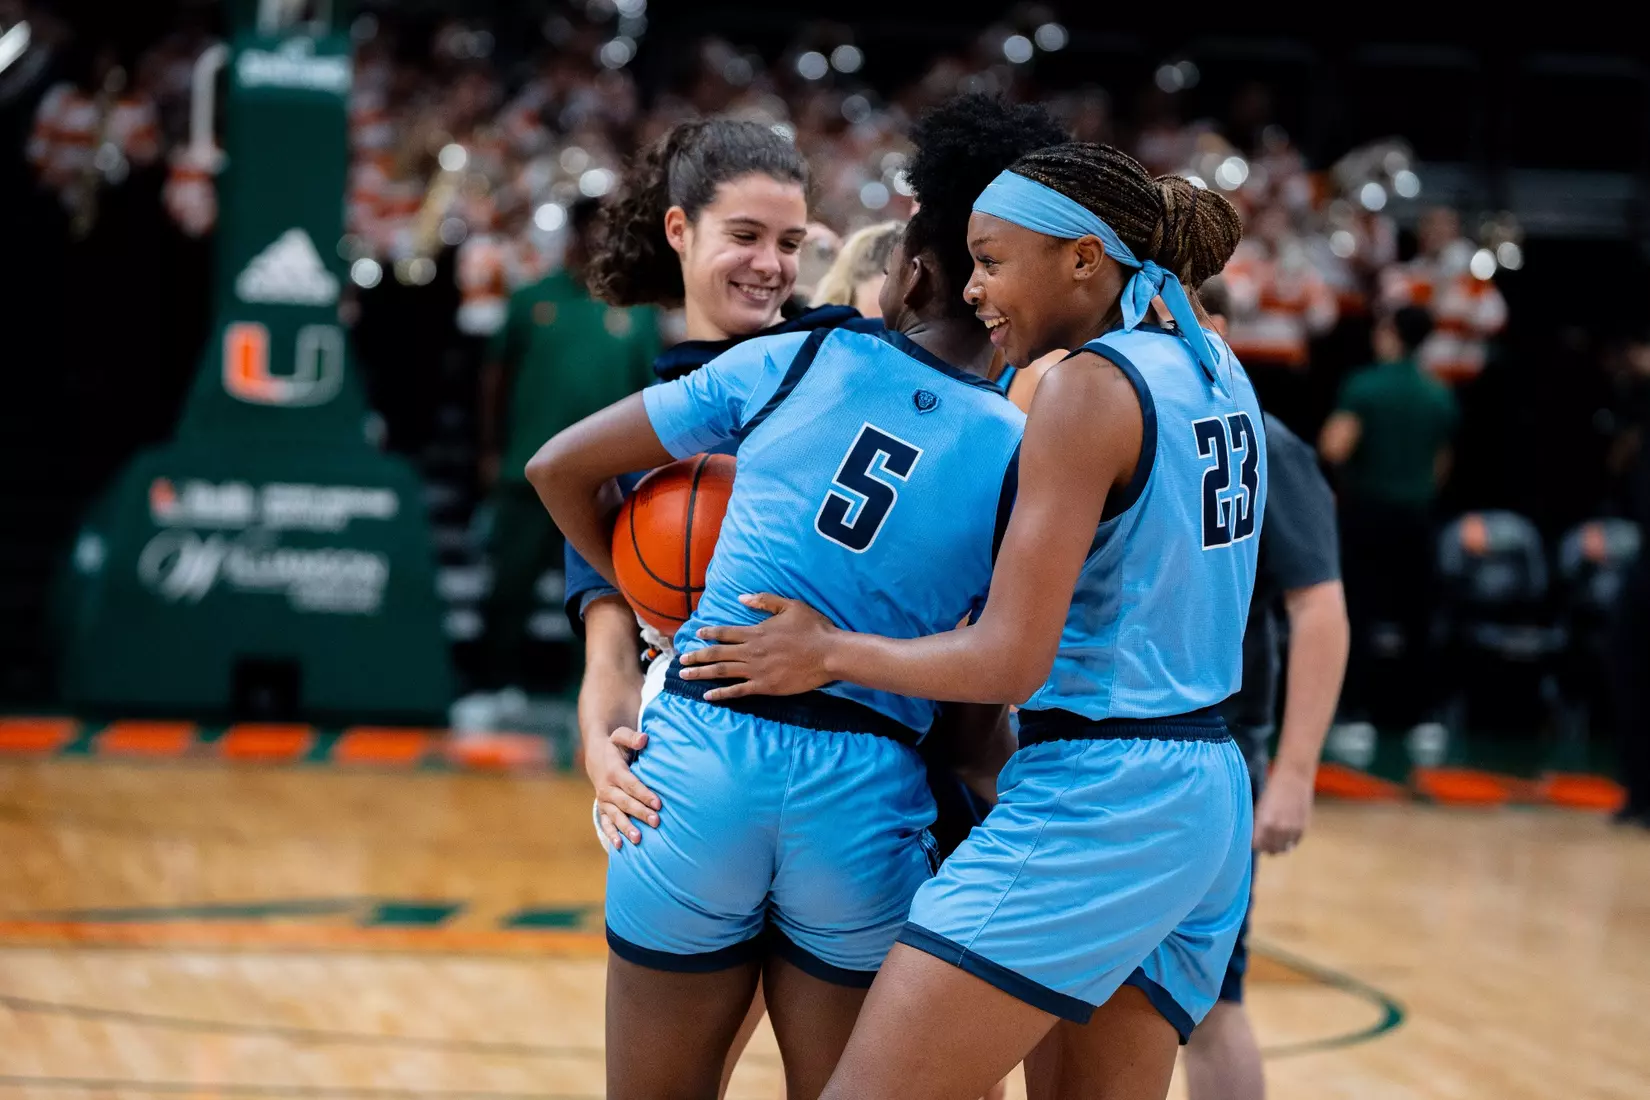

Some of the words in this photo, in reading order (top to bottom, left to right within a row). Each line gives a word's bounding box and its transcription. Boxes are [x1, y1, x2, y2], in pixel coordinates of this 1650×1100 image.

[223, 321, 345, 407] U
[814, 421, 924, 554] 5
[1192, 411, 1259, 551] 23
